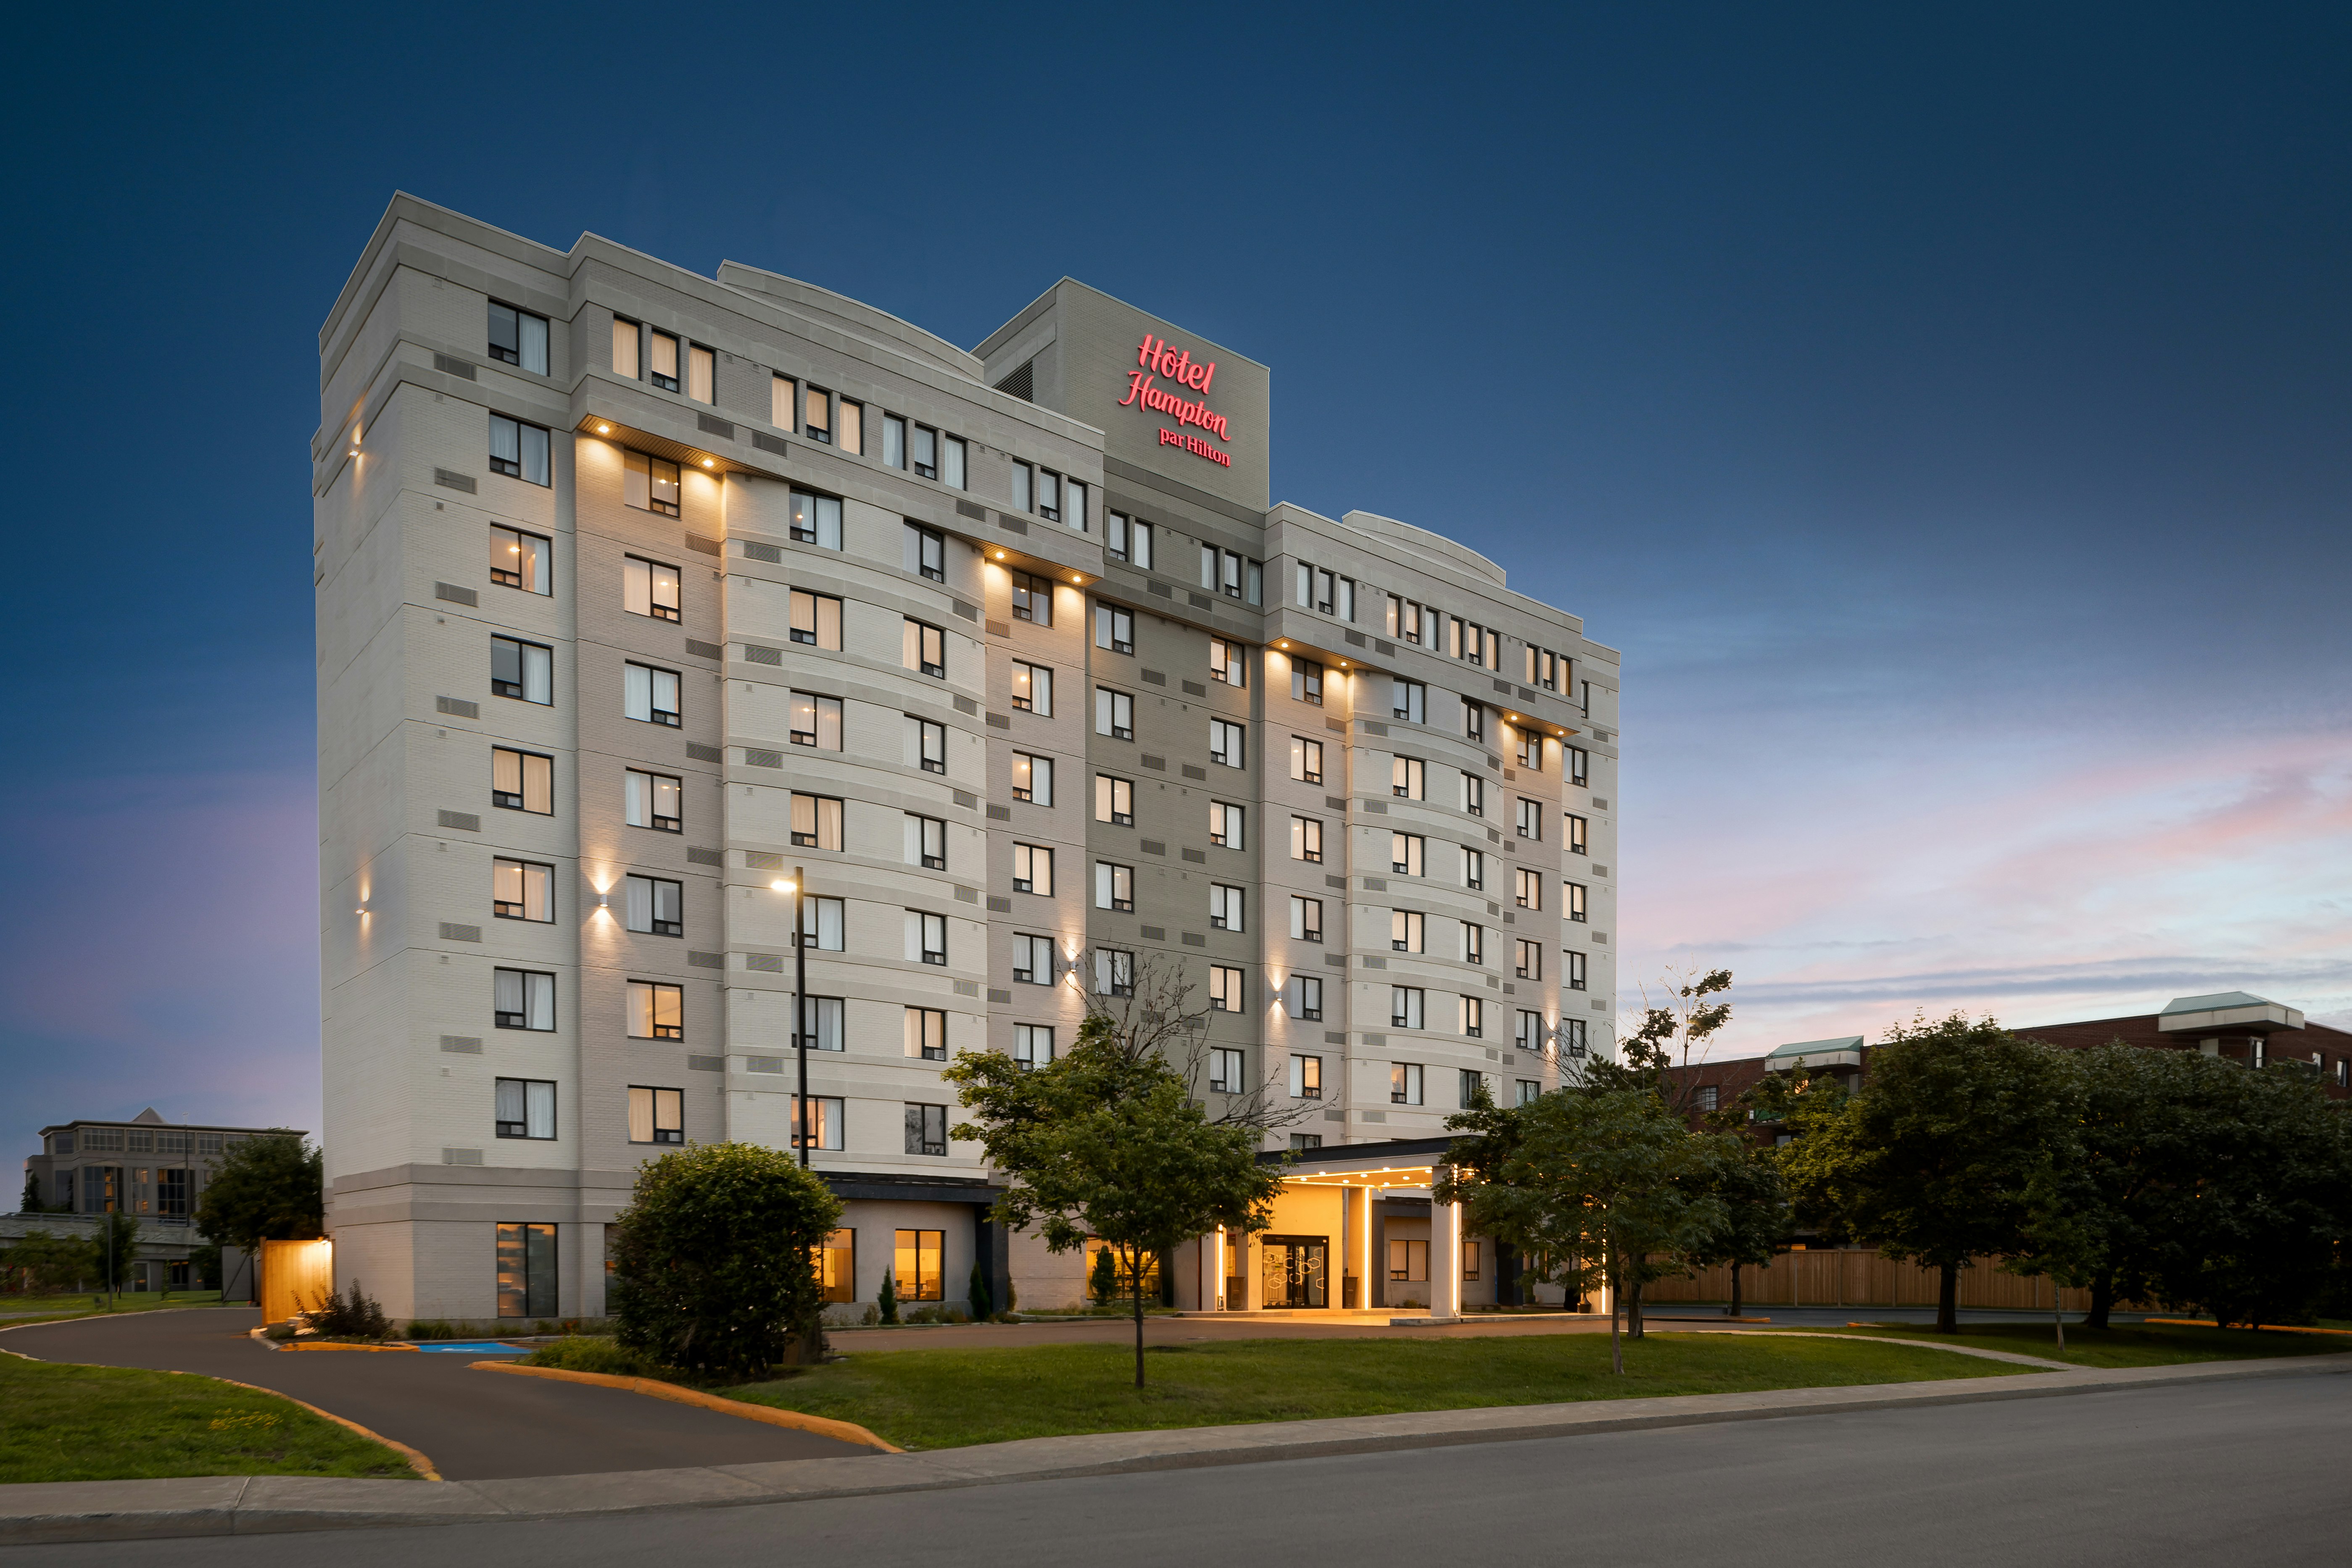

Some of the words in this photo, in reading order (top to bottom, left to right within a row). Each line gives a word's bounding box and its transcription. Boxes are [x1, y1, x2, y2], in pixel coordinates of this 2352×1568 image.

[1138, 333, 1216, 395] Hôtel
[1118, 370, 1231, 441] Hampton
[1159, 427, 1185, 447] par
[1186, 434, 1231, 467] Hilton
